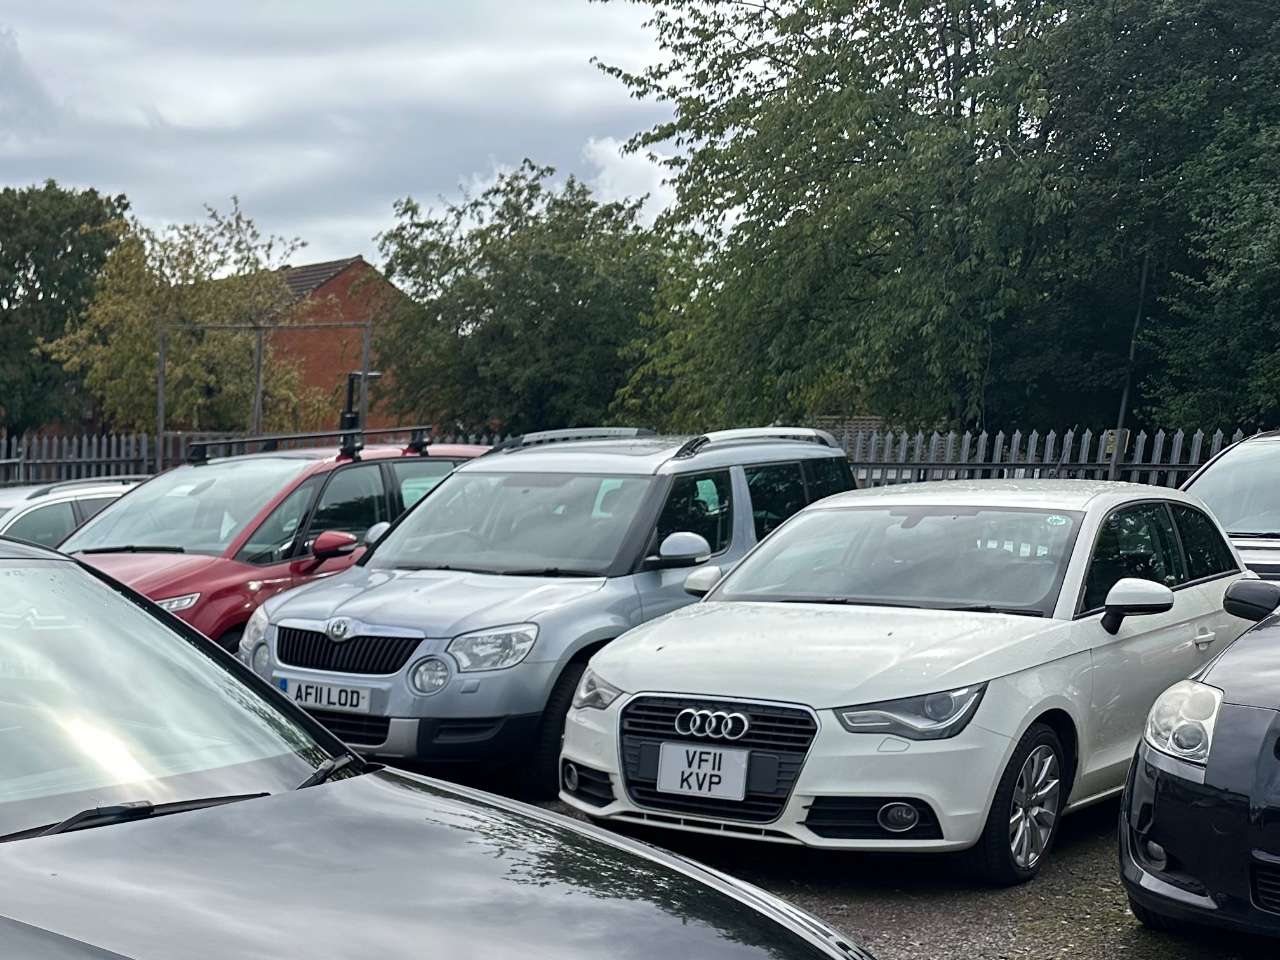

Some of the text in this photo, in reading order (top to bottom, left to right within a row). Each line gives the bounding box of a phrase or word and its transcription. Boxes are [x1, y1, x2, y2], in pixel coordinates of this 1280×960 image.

[295, 684, 360, 708] AF11 LOD
[685, 749, 723, 772] VF11
[679, 770, 722, 792] KVP
